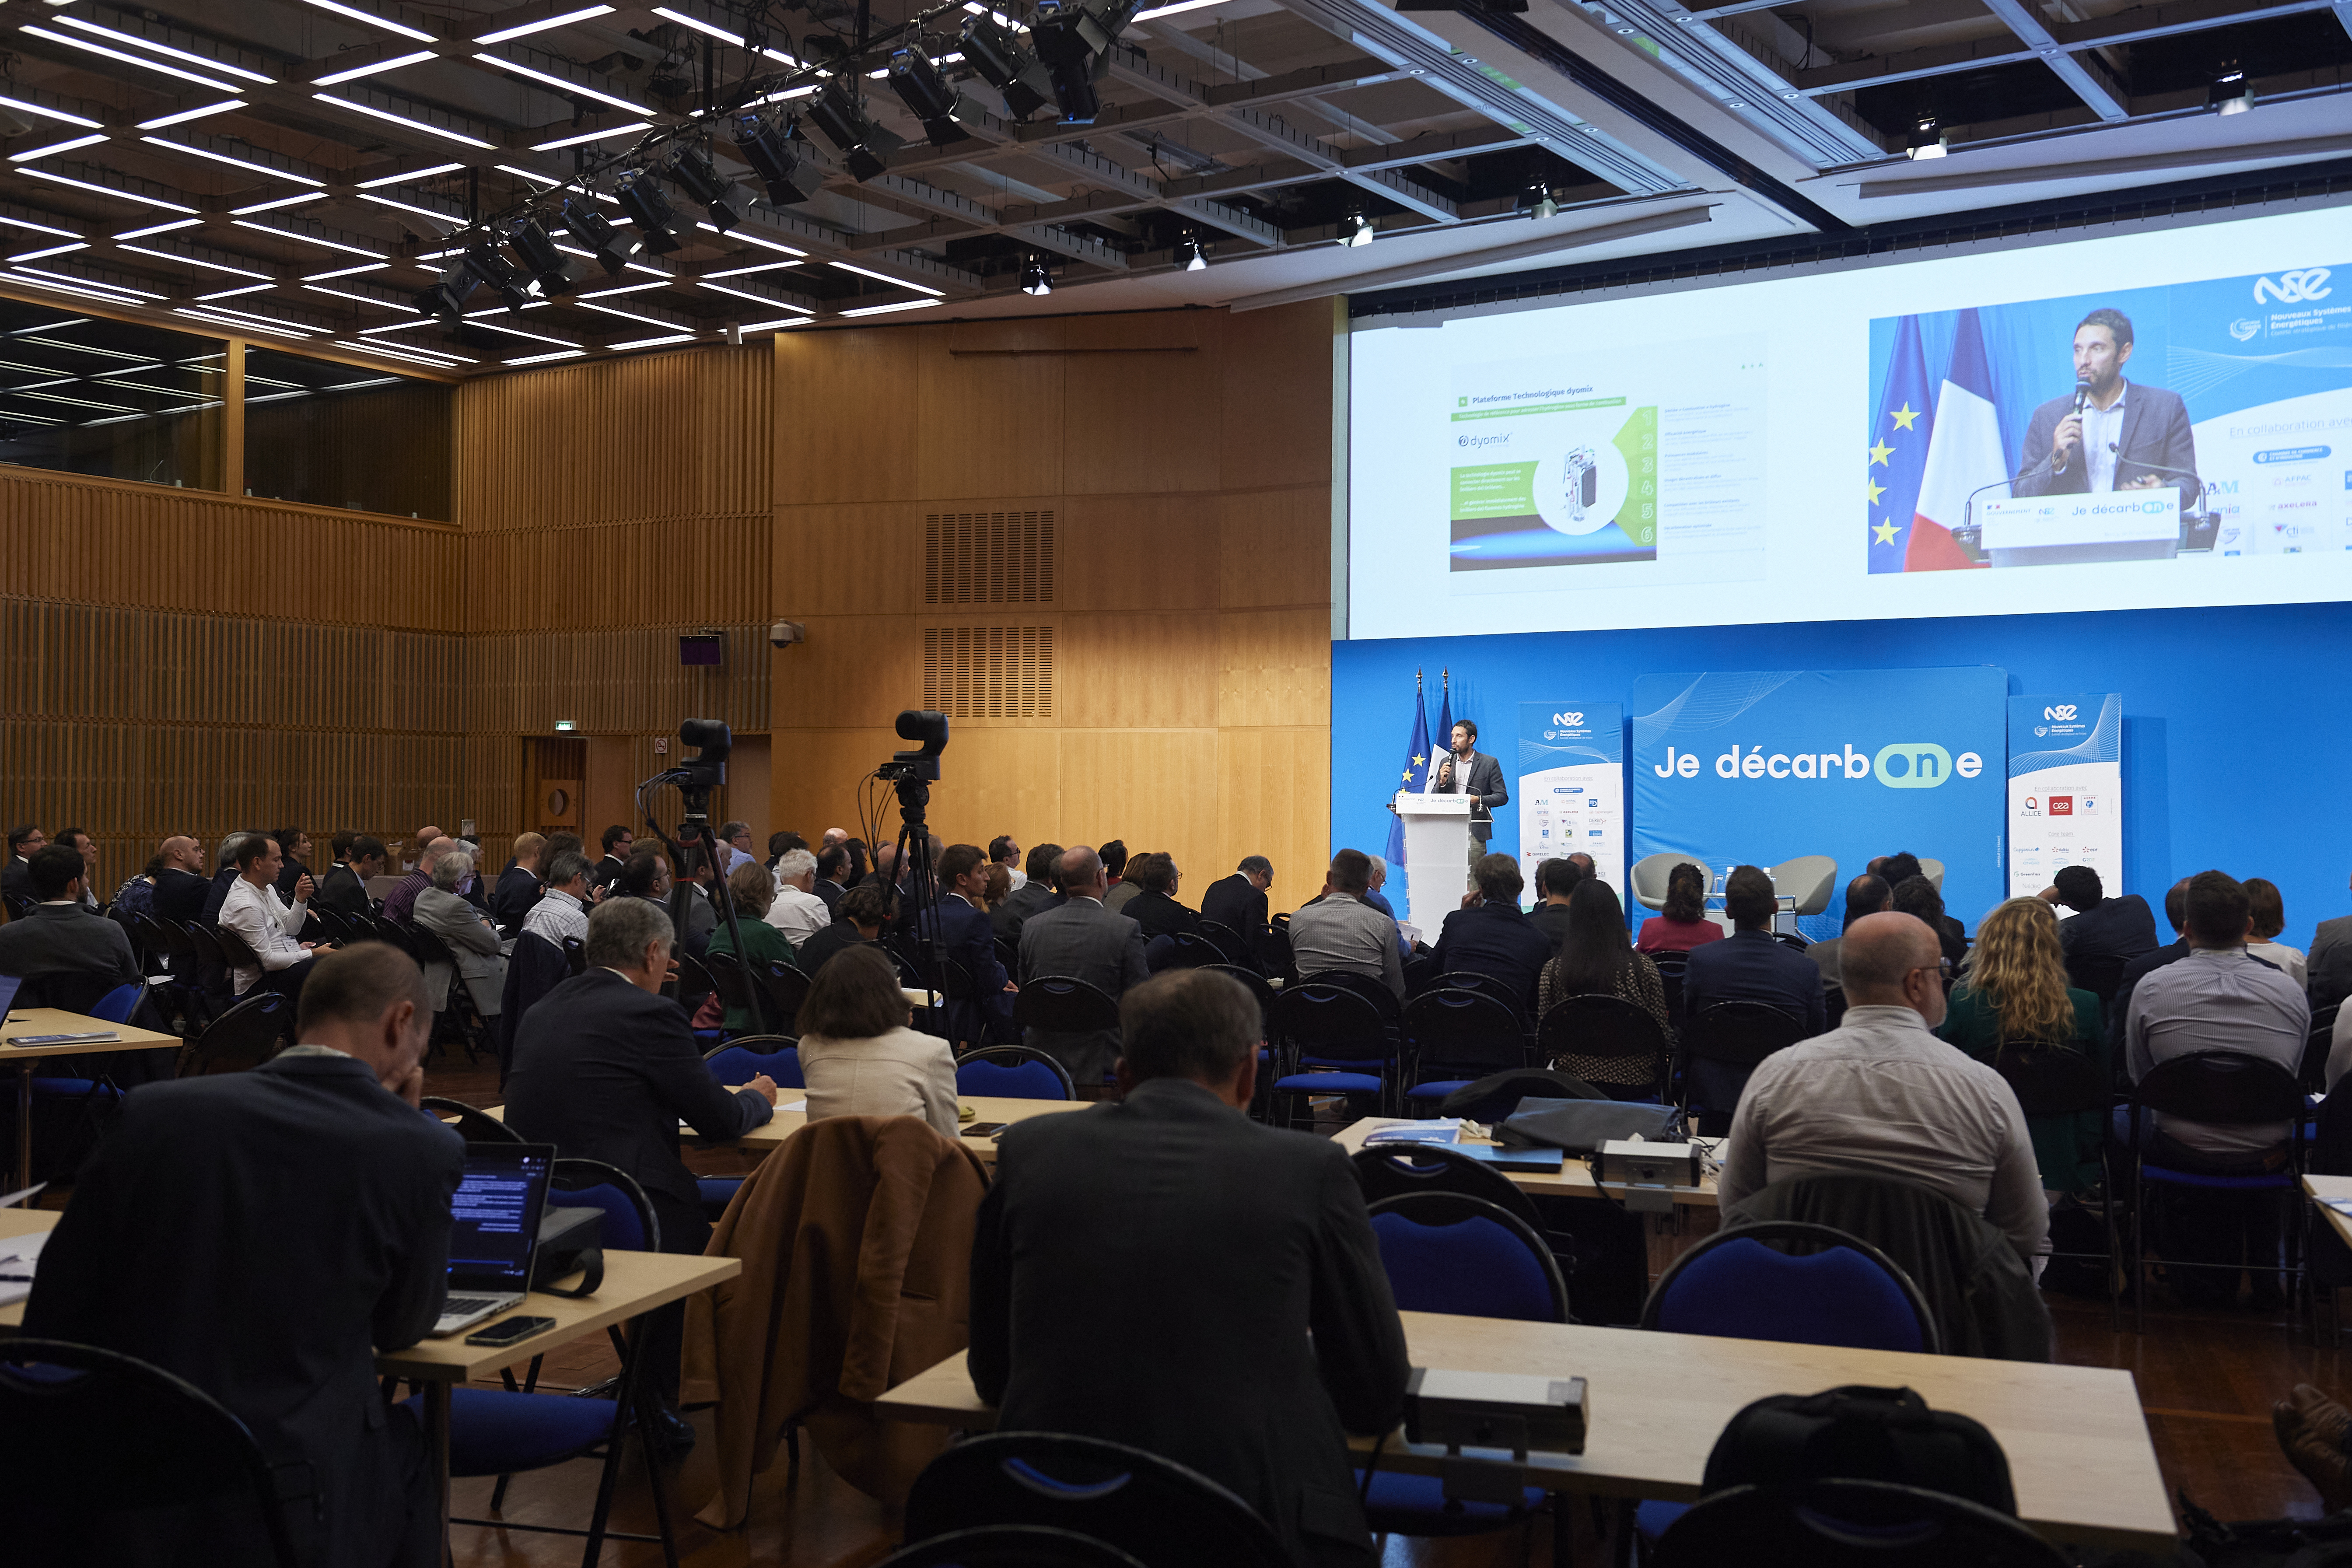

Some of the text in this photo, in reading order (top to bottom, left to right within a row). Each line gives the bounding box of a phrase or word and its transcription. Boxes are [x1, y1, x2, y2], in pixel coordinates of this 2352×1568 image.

[1473, 385, 1593, 403] Plateforme Technologique dyomix
[2230, 417, 2352, 437] En collaboration ave
[1470, 433, 1510, 449] dyomix
[1643, 434, 1653, 449] 2
[1642, 457, 1653, 473] 3
[1642, 480, 1653, 496] 4
[1642, 503, 1653, 519] 5
[2072, 501, 2174, 516] Je décarbone
[1642, 526, 1653, 542] 6
[1654, 744, 1983, 779] Je décarbone
